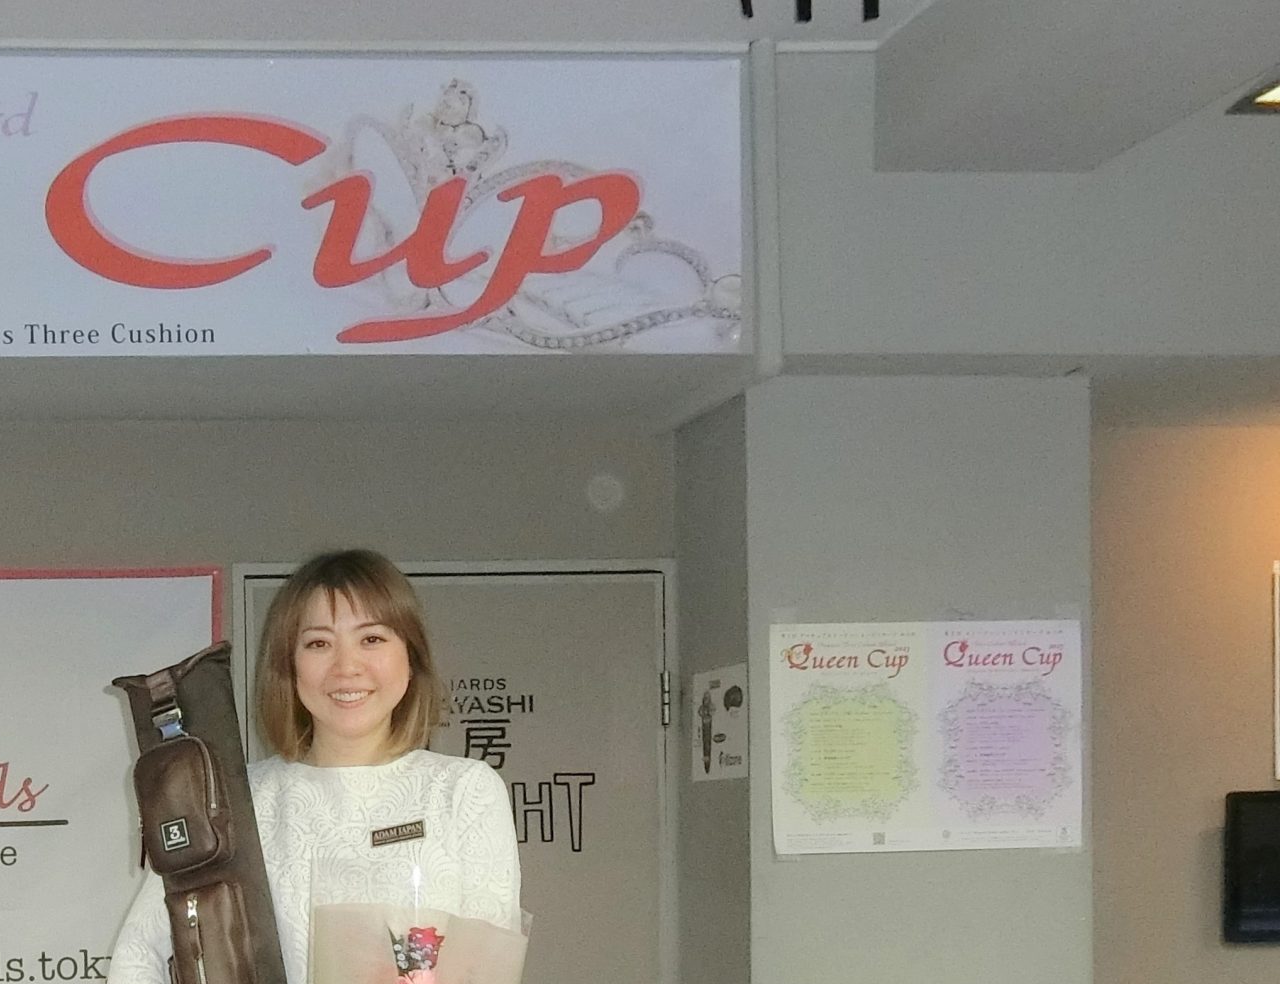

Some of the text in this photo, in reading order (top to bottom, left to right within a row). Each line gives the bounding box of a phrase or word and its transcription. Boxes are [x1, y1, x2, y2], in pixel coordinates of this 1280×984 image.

[45, 112, 644, 343] Cup
[24, 324, 100, 345] Three
[111, 323, 216, 344] Cushion
[787, 641, 910, 679] Queen Cup
[943, 640, 1063, 677] Queen Cup
[450, 678, 507, 692] IARDS
[451, 694, 535, 715] YASHI
[511, 772, 596, 852] HT
[374, 828, 398, 842] ADAM
[398, 822, 423, 836] JAPAN
